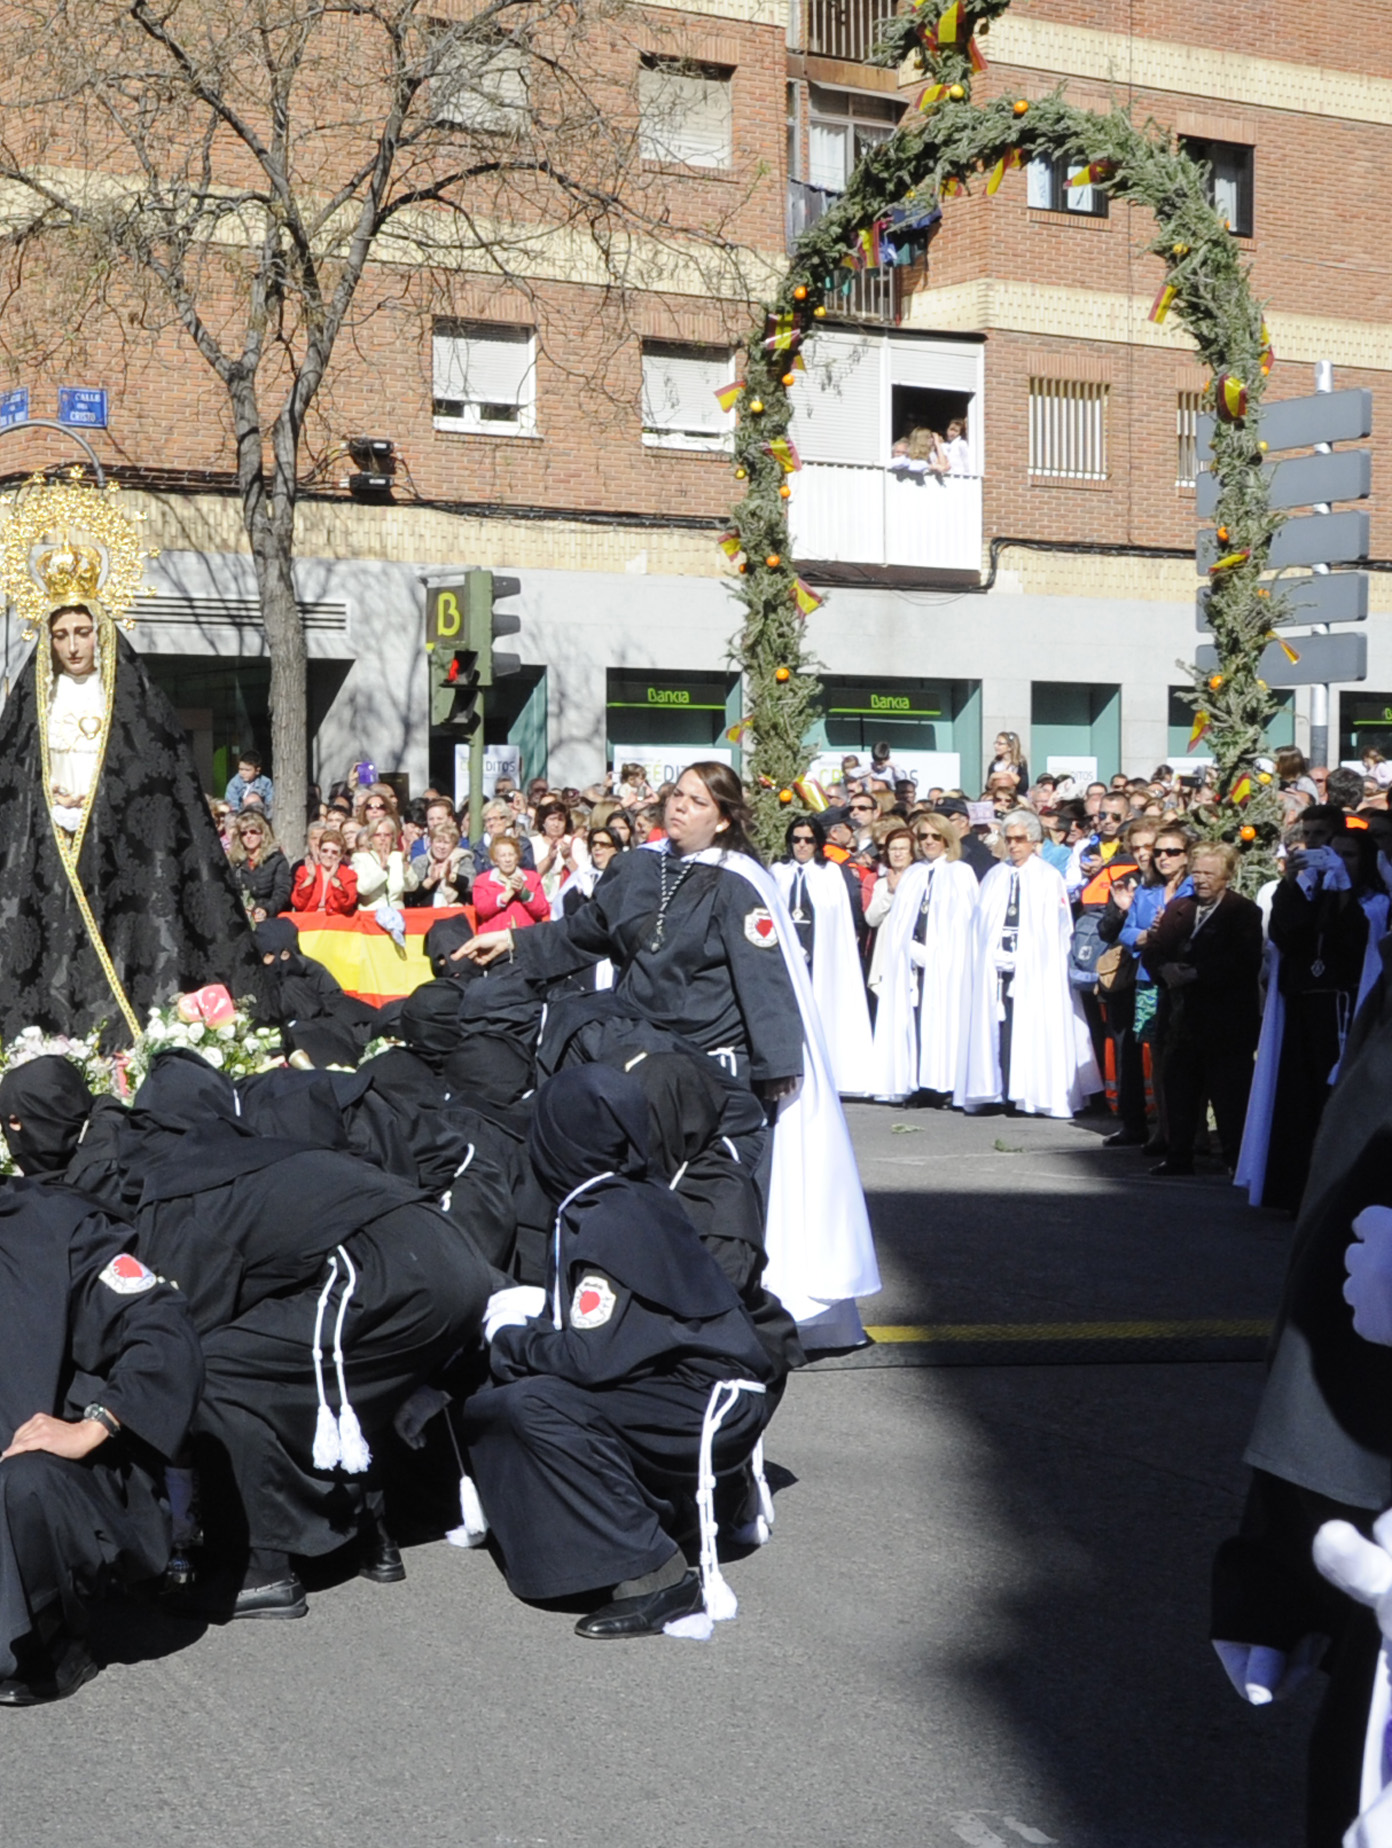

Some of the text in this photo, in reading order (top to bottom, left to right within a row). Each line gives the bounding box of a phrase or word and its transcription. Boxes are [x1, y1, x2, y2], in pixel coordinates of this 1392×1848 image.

[75, 391, 101, 402] CALLE
[70, 411, 96, 423] CRISTO
[436, 592, 461, 637] B
[648, 688, 690, 703] Bankia
[871, 694, 910, 709] Bankia
